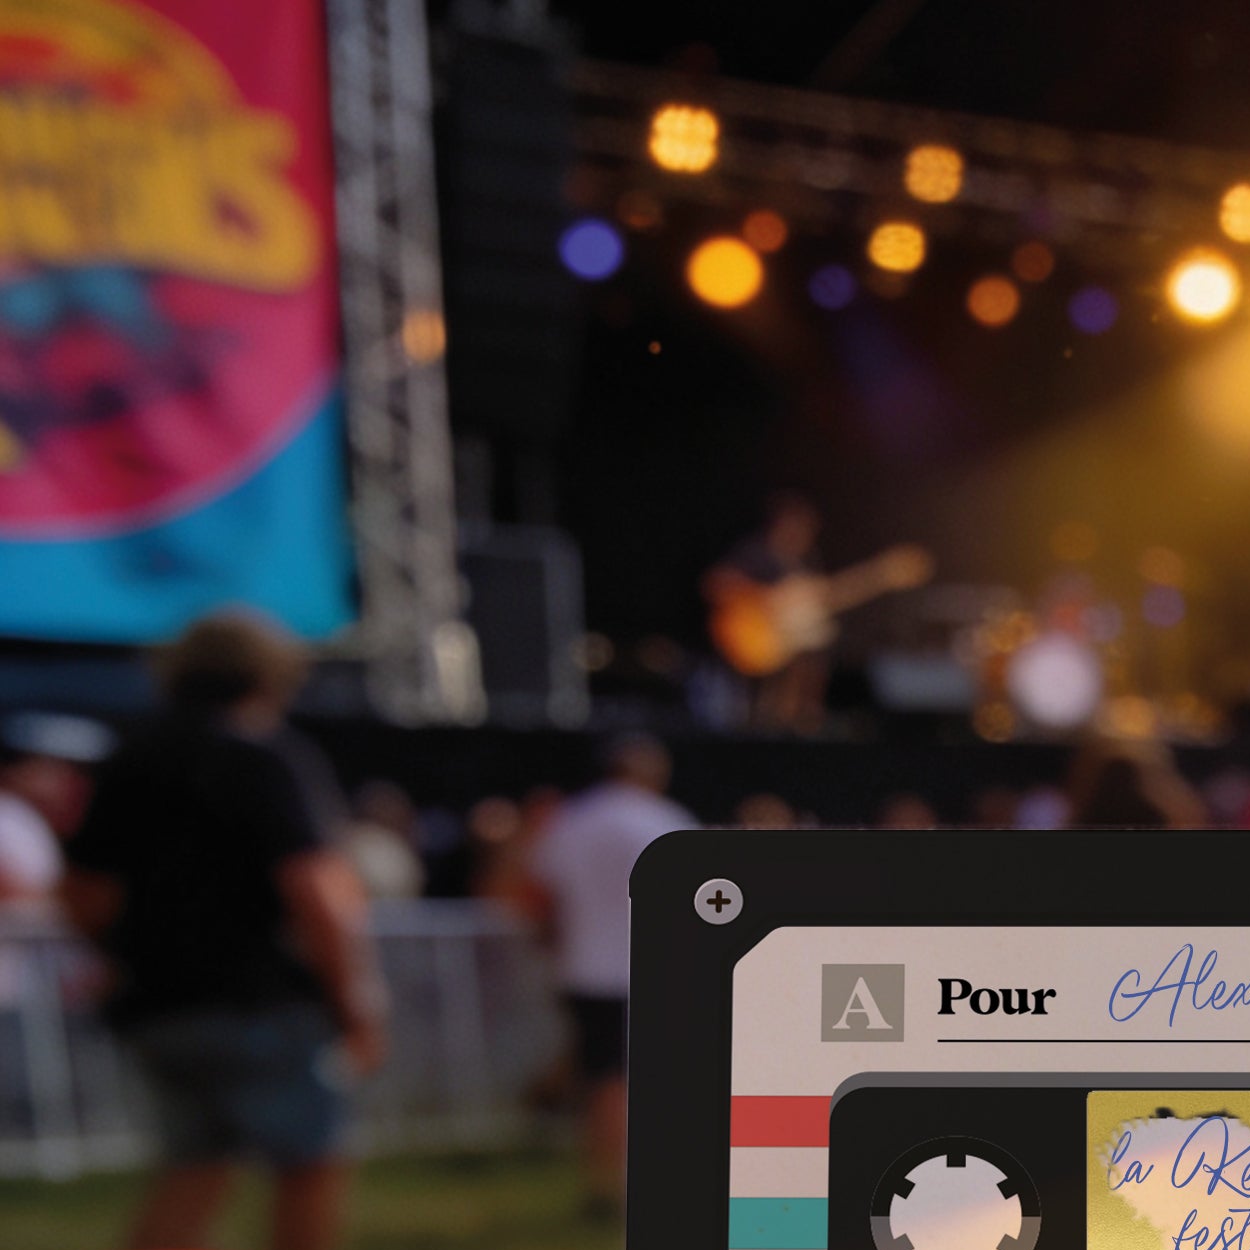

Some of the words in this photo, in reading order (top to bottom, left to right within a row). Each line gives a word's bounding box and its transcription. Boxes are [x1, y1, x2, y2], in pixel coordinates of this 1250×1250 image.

[833, 976, 893, 1029] A
[938, 978, 1057, 1016] Pour
[1108, 1130, 1154, 1191] la
